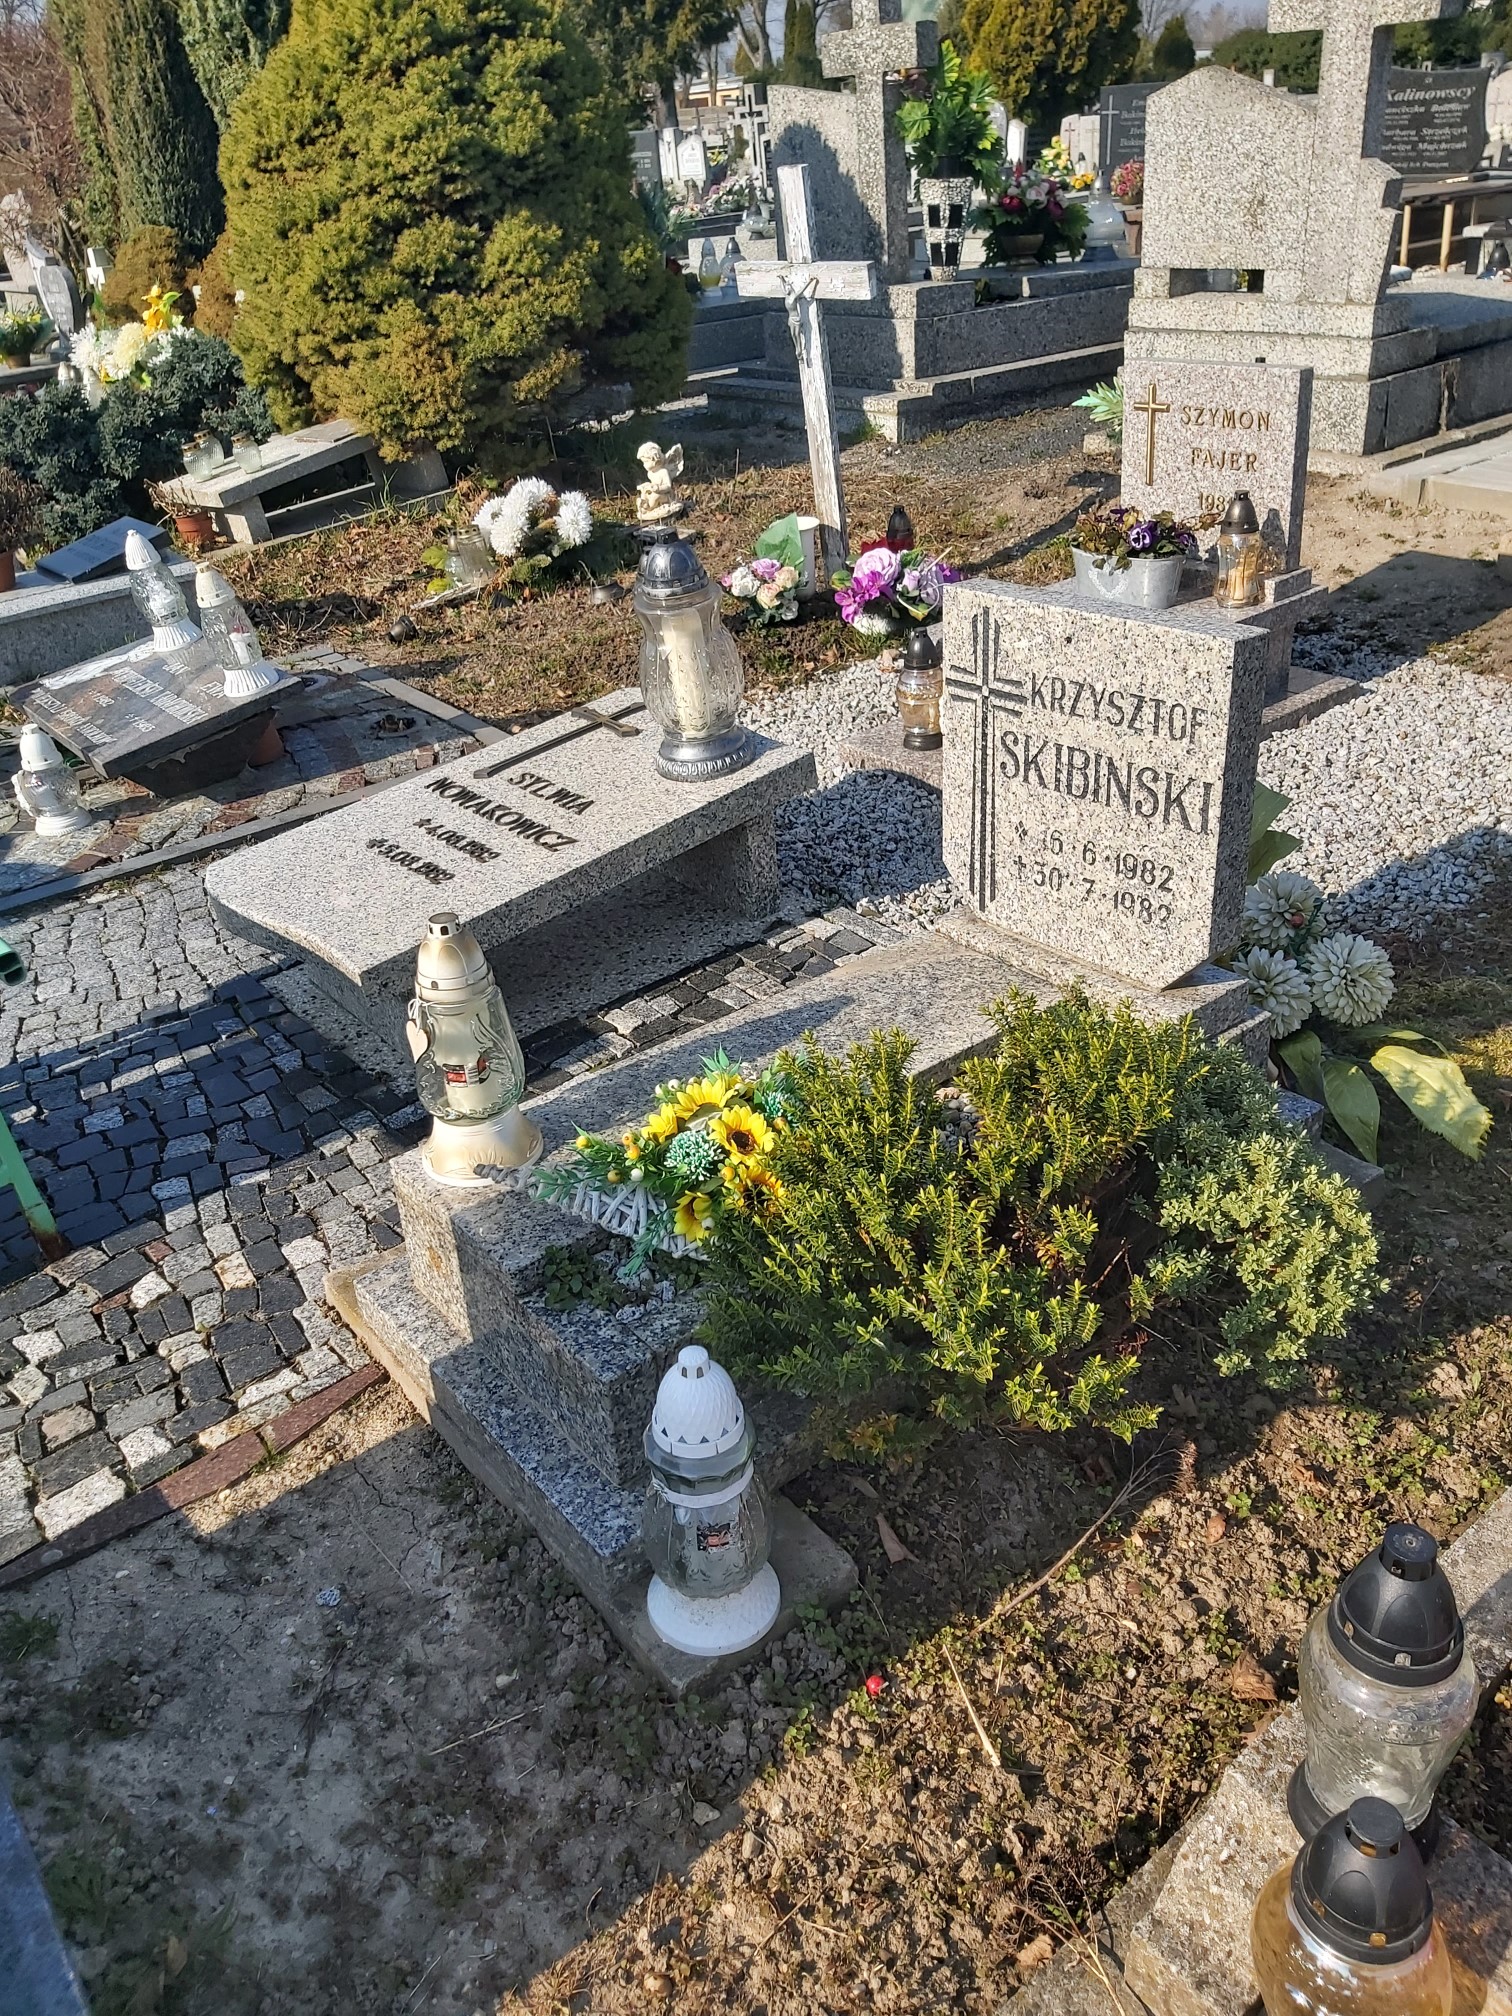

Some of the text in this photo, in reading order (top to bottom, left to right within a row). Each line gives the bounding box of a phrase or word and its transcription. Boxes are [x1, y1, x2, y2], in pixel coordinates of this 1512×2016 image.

[1180, 405, 1271, 432] SZYMON
[1190, 446, 1258, 473] FAJER
[1198, 490, 1232, 513] 198
[1031, 672, 1208, 745] KRZYSZTOF
[507, 772, 595, 816] SYLWIA
[423, 776, 580, 853] NOWAKOWICZ
